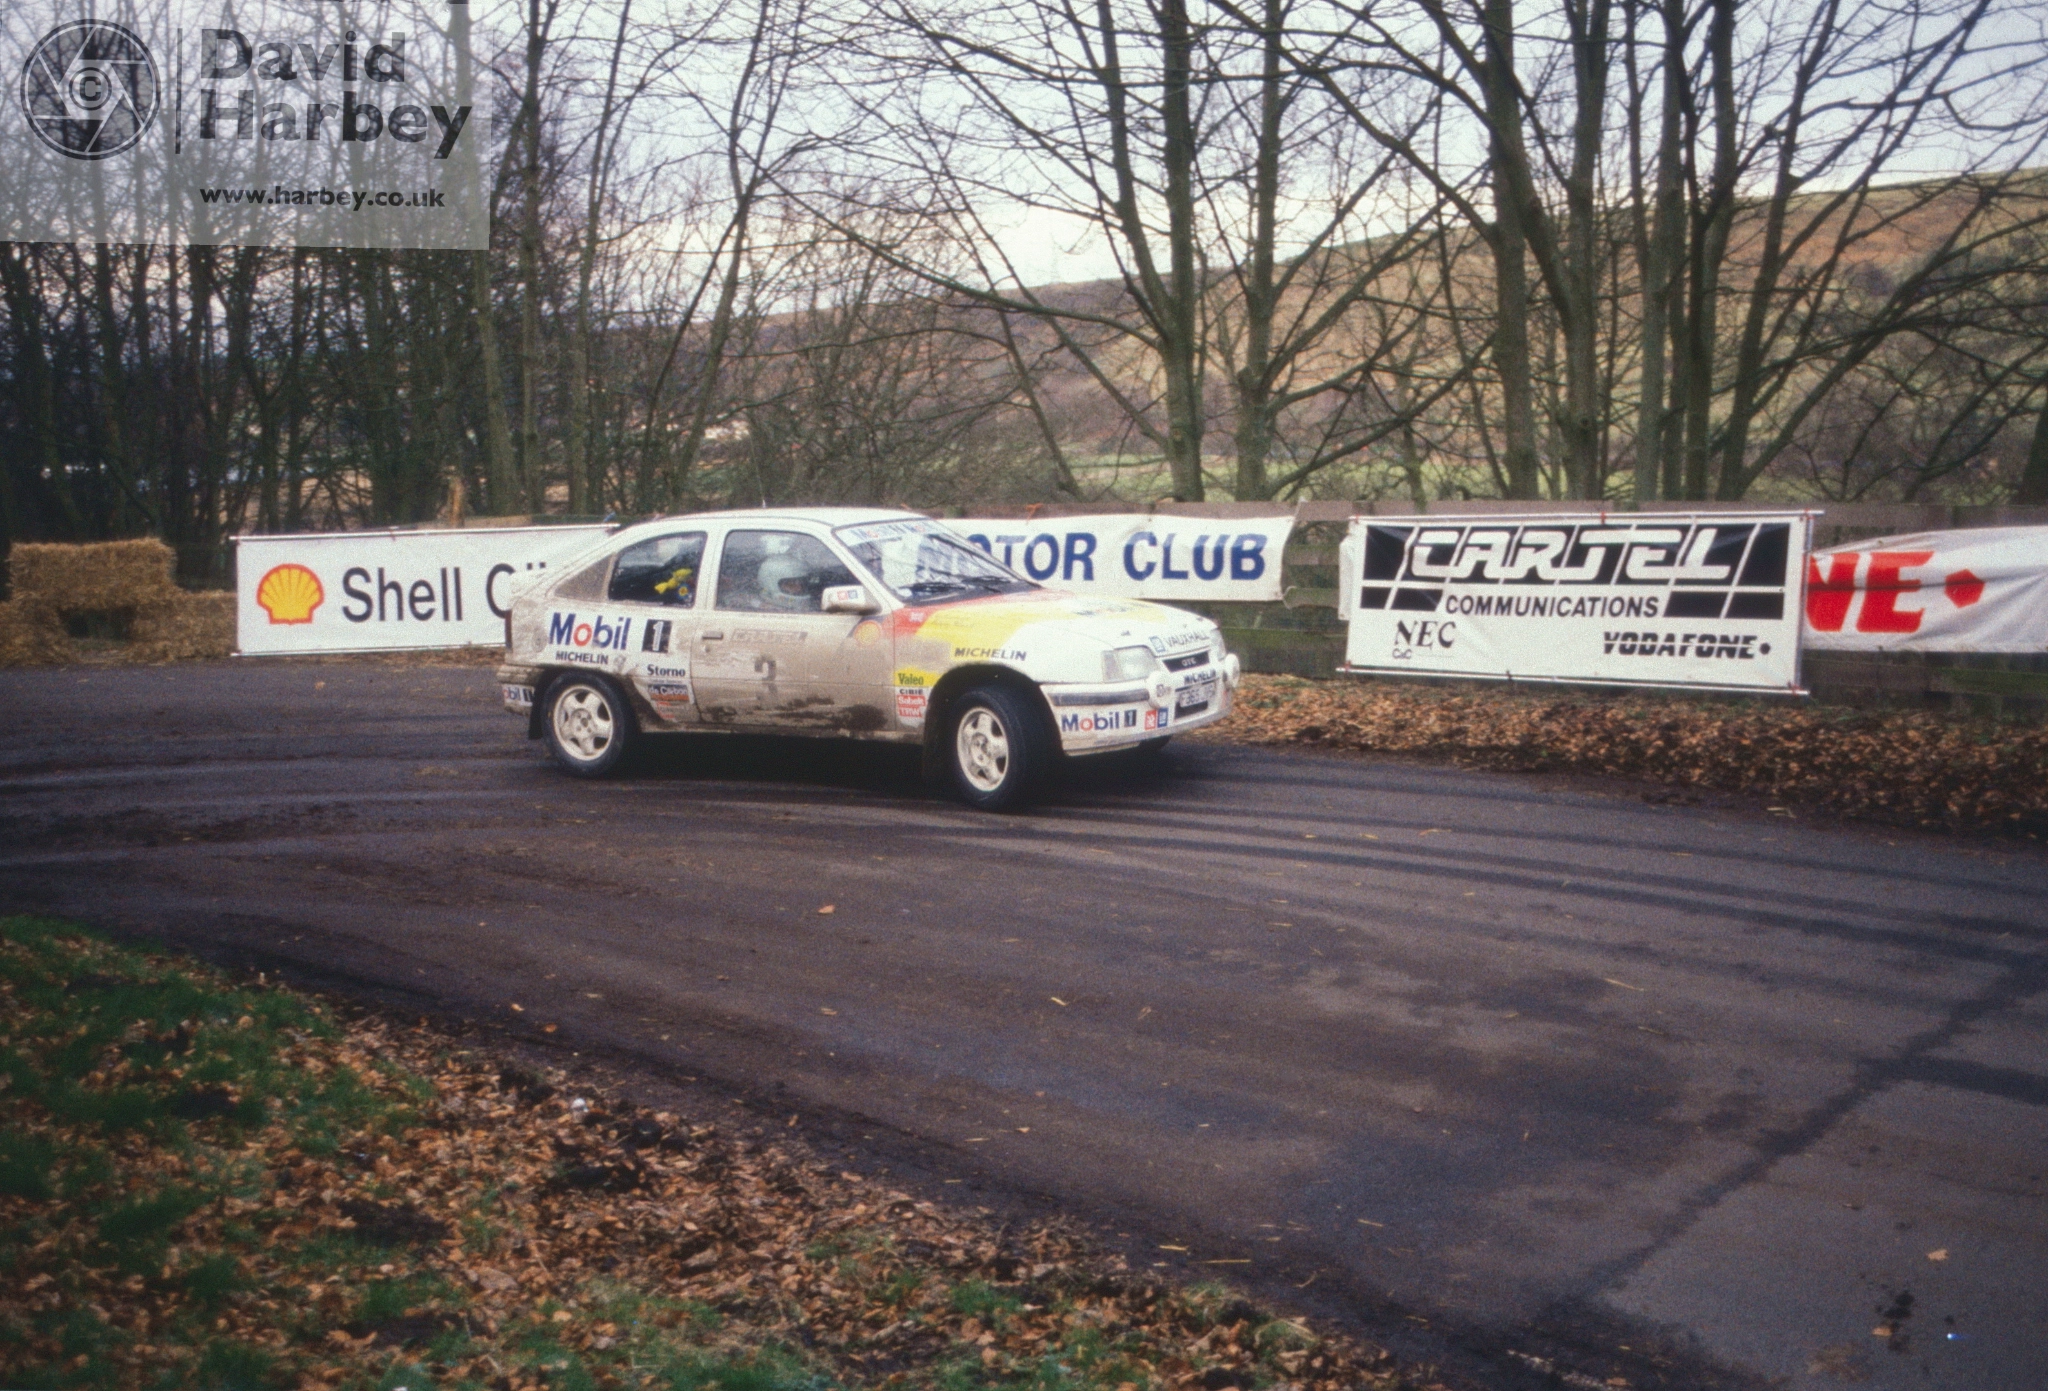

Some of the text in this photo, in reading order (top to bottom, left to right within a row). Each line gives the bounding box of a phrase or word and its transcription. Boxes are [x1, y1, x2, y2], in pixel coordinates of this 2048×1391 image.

[1123, 531, 1267, 581] CLUB
[1411, 528, 1731, 581] CARTEL
[342, 566, 463, 622] Shell
[1445, 595, 1659, 617] COMMUNICATIONS
[549, 612, 632, 650] Mobil
[1394, 619, 1457, 648] NEC
[555, 651, 609, 664] MICHELIN
[954, 647, 1027, 661] MICHELIN
[1603, 631, 1757, 659] VODAFONE
[647, 664, 686, 677] Storno
[898, 673, 924, 685] Valeo
[1061, 710, 1120, 732] Mobil
